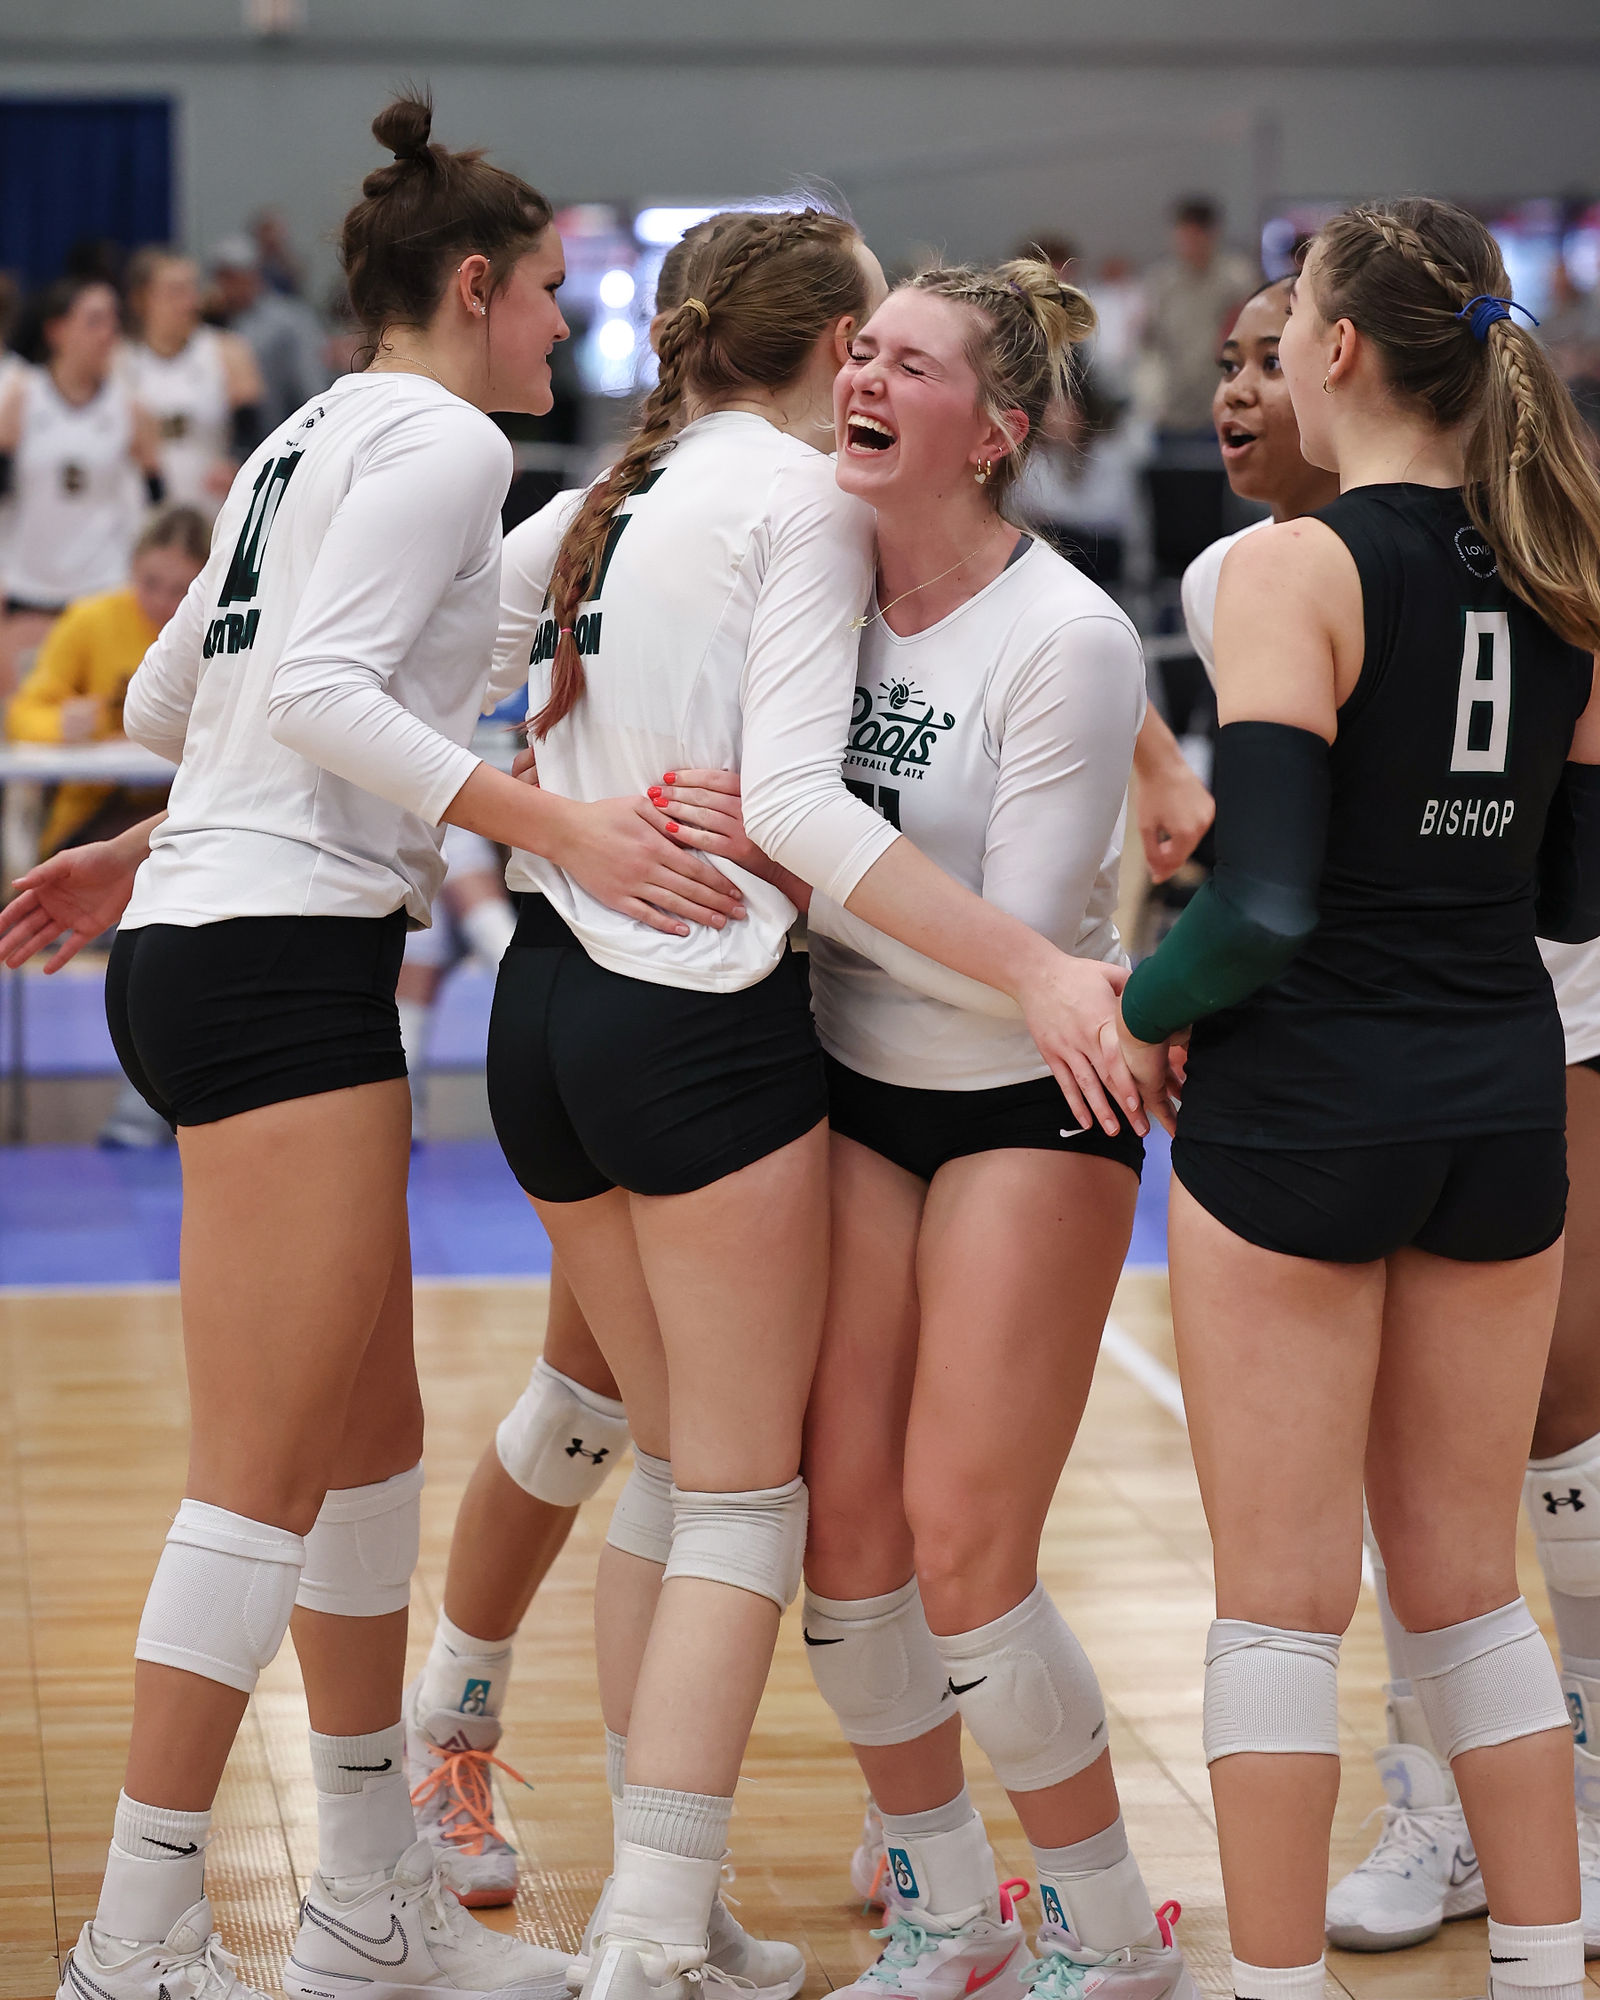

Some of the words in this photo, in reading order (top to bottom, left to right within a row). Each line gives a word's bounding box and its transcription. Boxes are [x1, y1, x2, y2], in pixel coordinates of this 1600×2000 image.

[1449, 611, 1512, 773] 8
[903, 767, 925, 780] ATX
[1419, 799, 1515, 838] BISHOP
